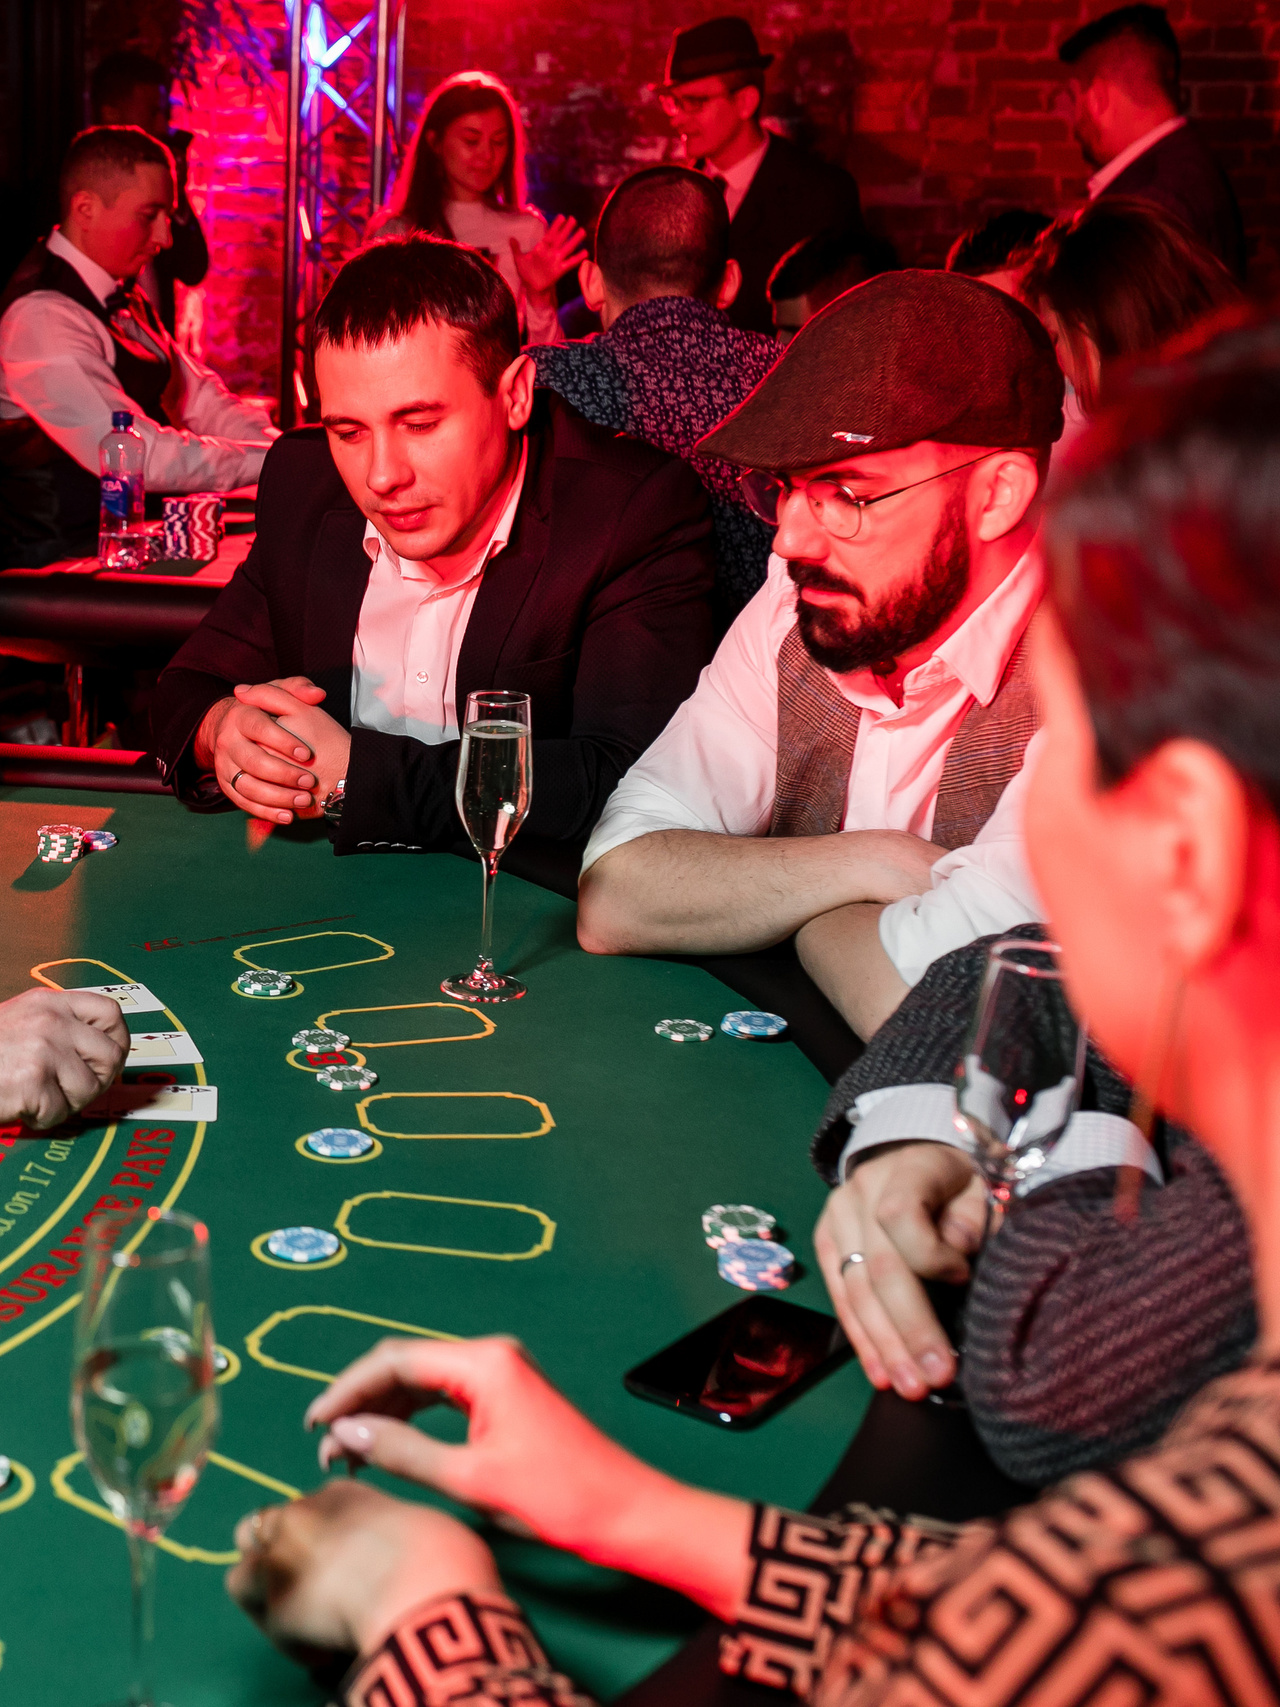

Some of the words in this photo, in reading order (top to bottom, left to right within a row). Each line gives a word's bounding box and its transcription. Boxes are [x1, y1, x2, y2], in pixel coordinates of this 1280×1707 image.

[306, 1052, 348, 1066] B
[190, 1086, 212, 1094] A
[44, 1137, 77, 1162] an
[110, 1128, 176, 1190] PAYS
[19, 1160, 56, 1188] 17
[4, 1186, 41, 1215] on
